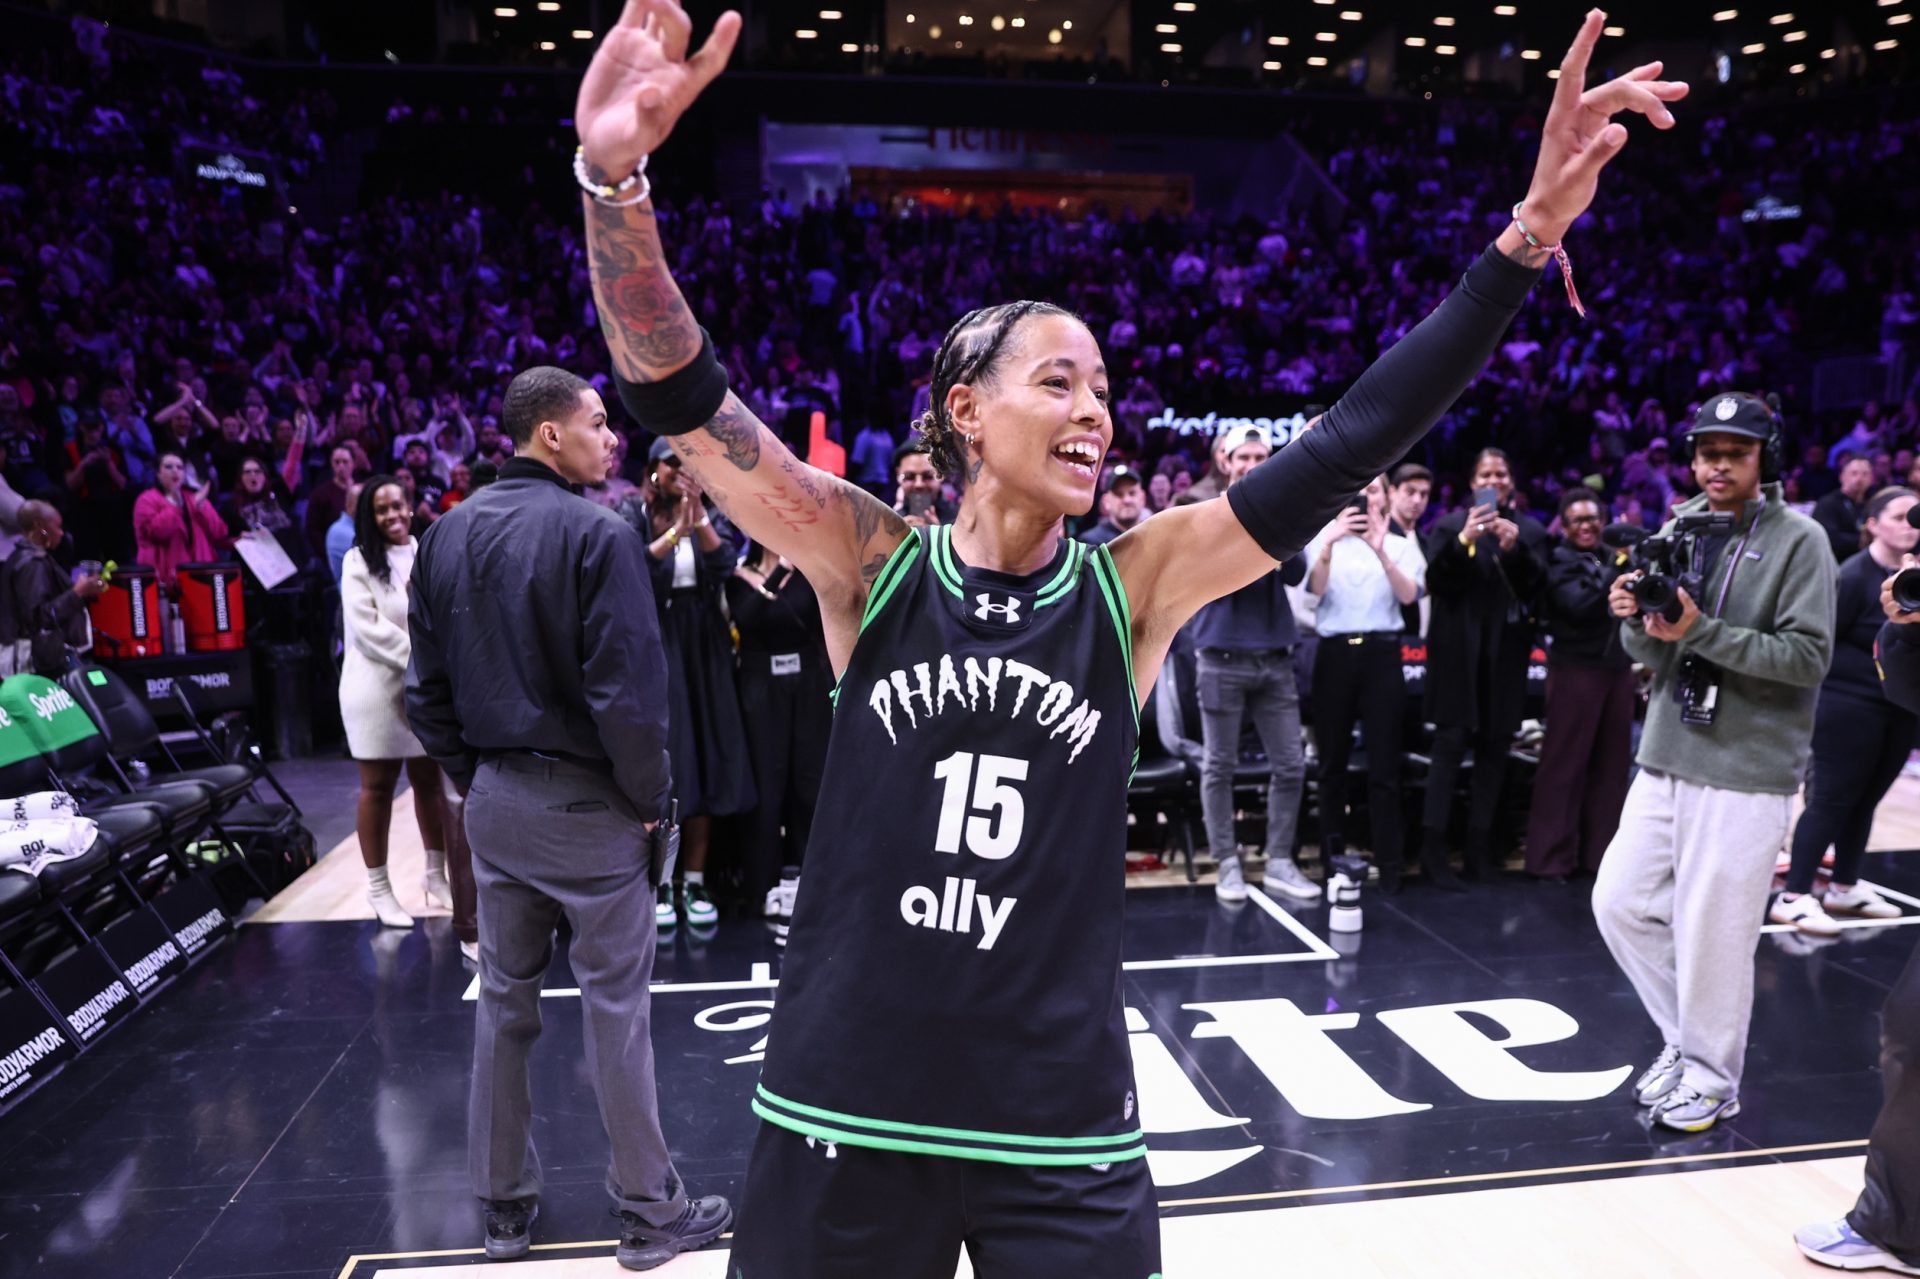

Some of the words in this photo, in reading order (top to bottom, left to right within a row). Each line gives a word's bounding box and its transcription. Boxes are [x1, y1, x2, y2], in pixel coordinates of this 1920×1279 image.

[28, 686, 74, 722] Sprite
[869, 654, 1101, 764] PHANTOM
[934, 751, 1029, 860] 15
[174, 907, 226, 949] BODYARMOR
[900, 876, 1017, 950] ally
[123, 940, 180, 988] BODYARMOR
[66, 980, 130, 1034] BODYARMOR
